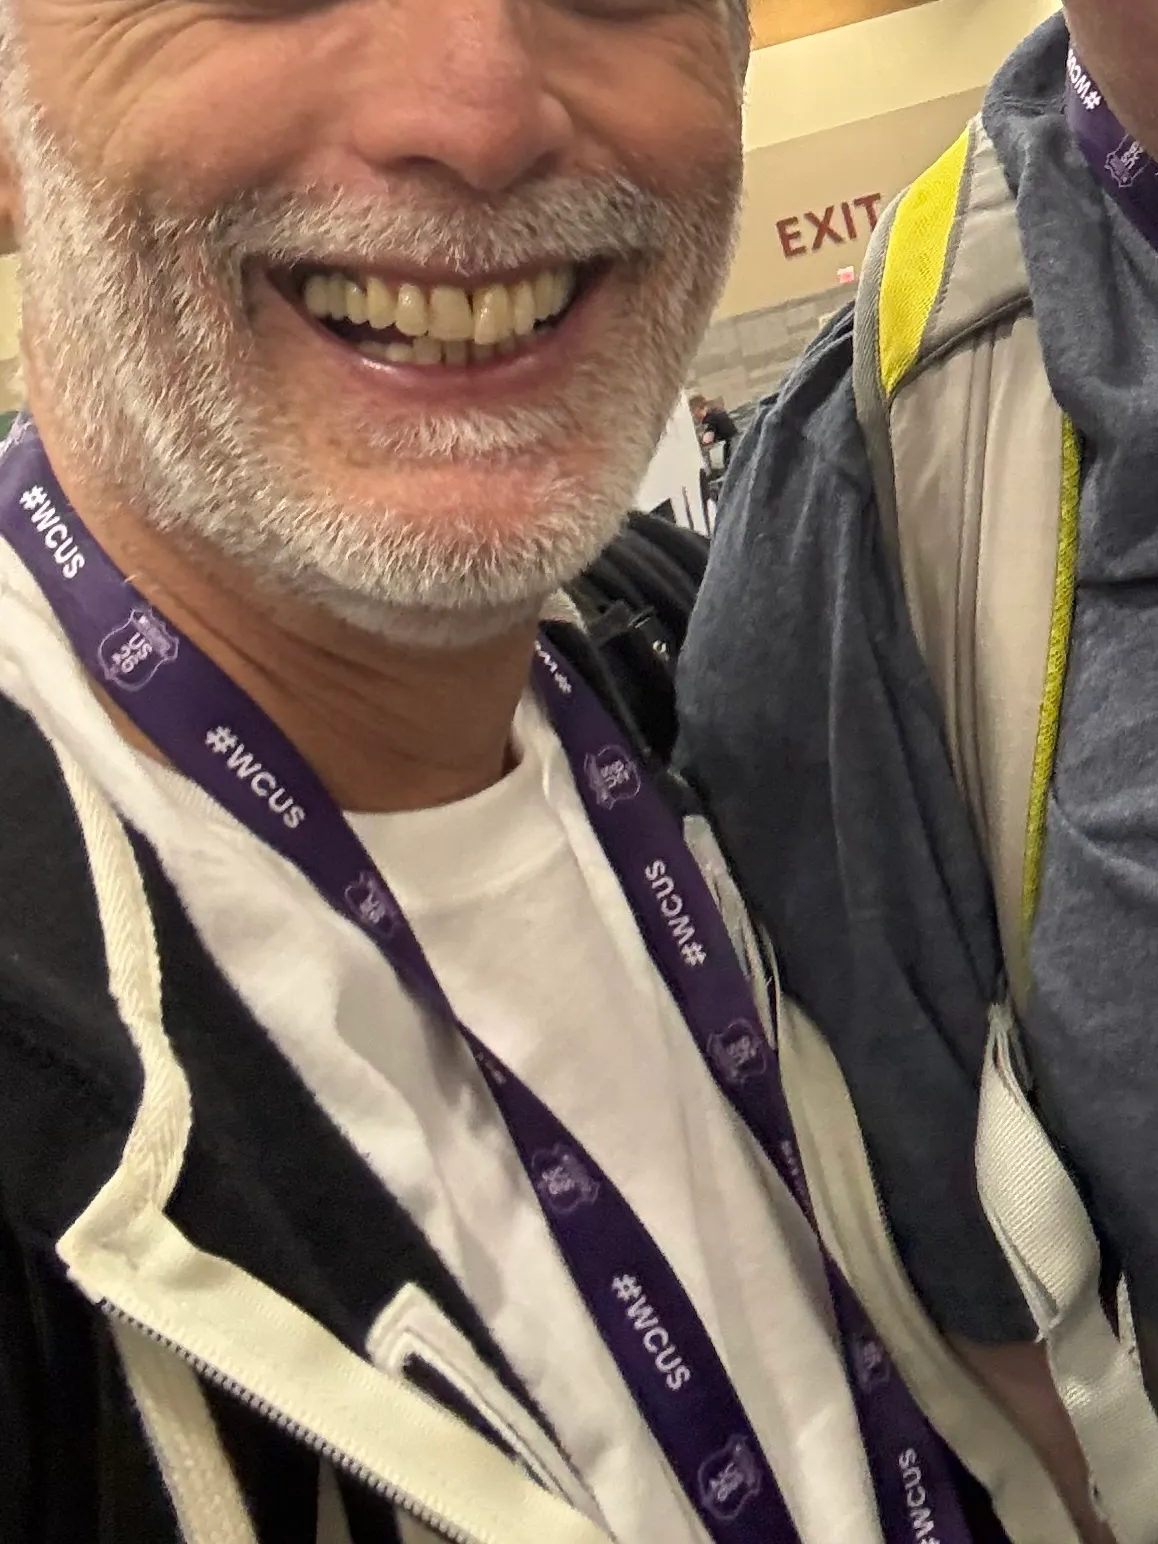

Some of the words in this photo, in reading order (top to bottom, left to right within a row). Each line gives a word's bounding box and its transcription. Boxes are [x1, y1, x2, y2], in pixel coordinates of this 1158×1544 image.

[775, 192, 883, 260] EXIT
[19, 484, 86, 579] #WCUS
[111, 645, 139, 673] 26
[129, 632, 153, 660] US
[205, 725, 306, 829] #WCUS
[645, 859, 707, 967] #WCUS
[611, 1274, 691, 1391] #WCUS
